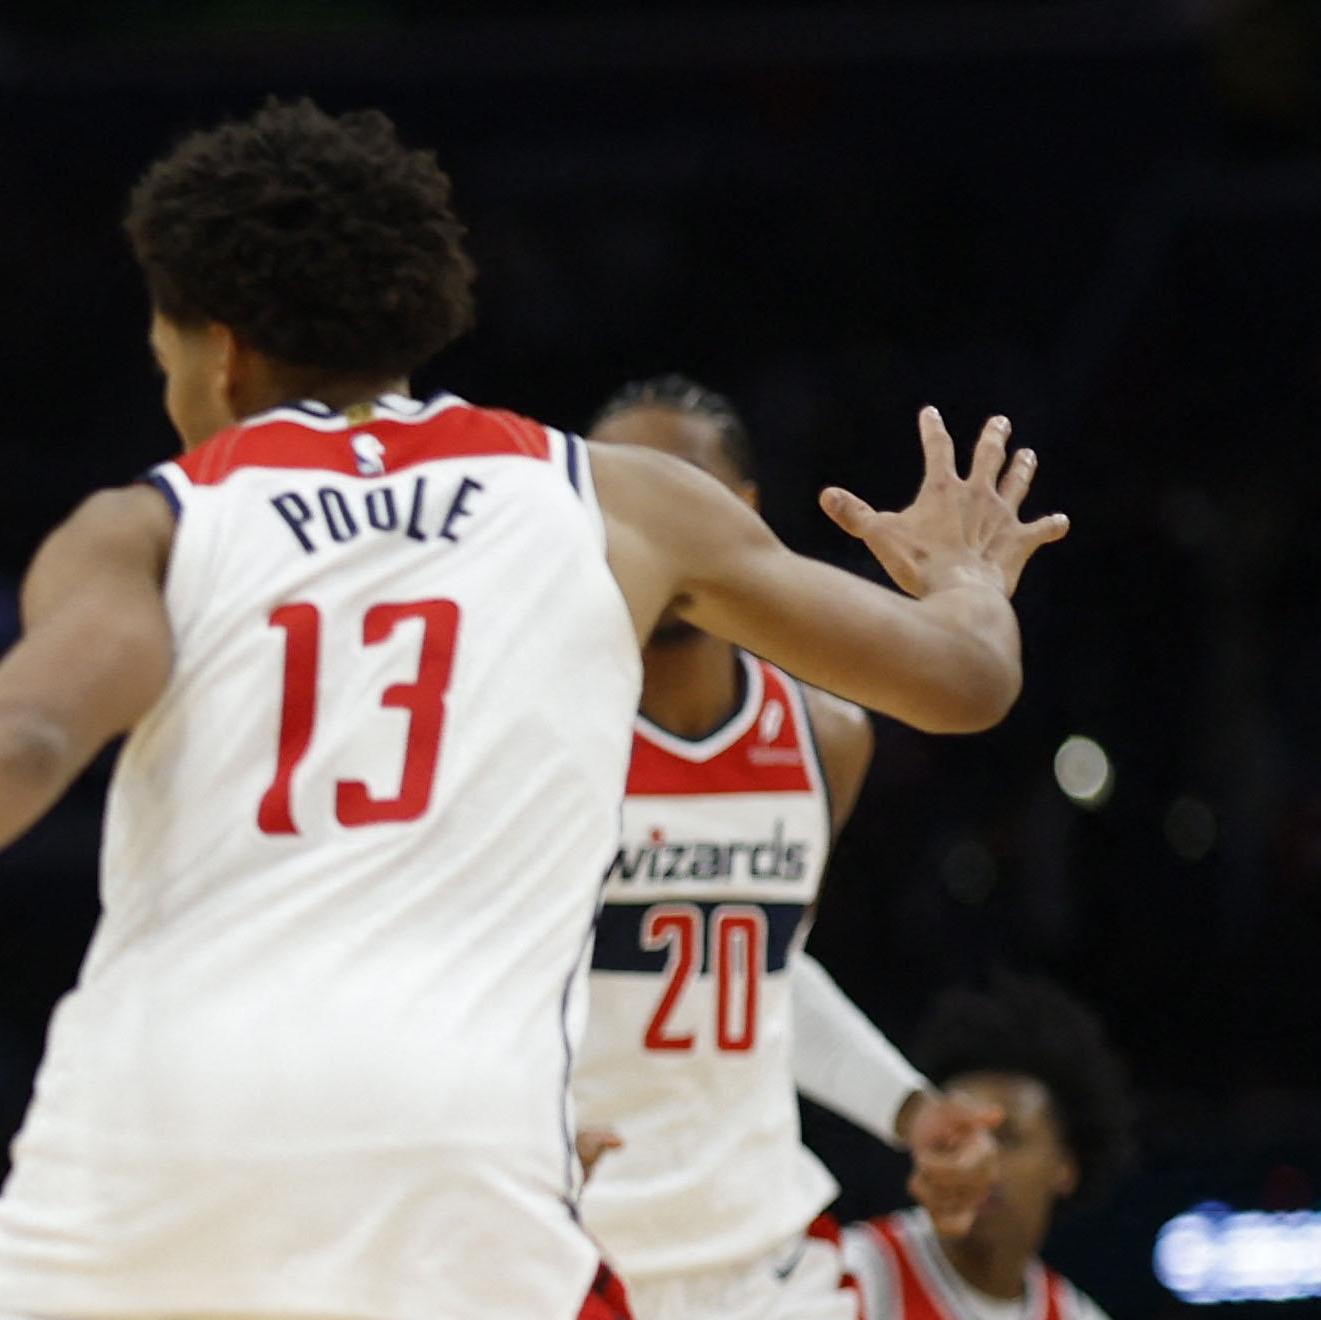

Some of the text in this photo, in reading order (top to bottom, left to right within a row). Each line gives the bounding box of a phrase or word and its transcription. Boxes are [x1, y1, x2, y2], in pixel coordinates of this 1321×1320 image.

[270, 475, 485, 555] POOLE
[257, 597, 462, 837] 13
[642, 906, 766, 1053] 20
